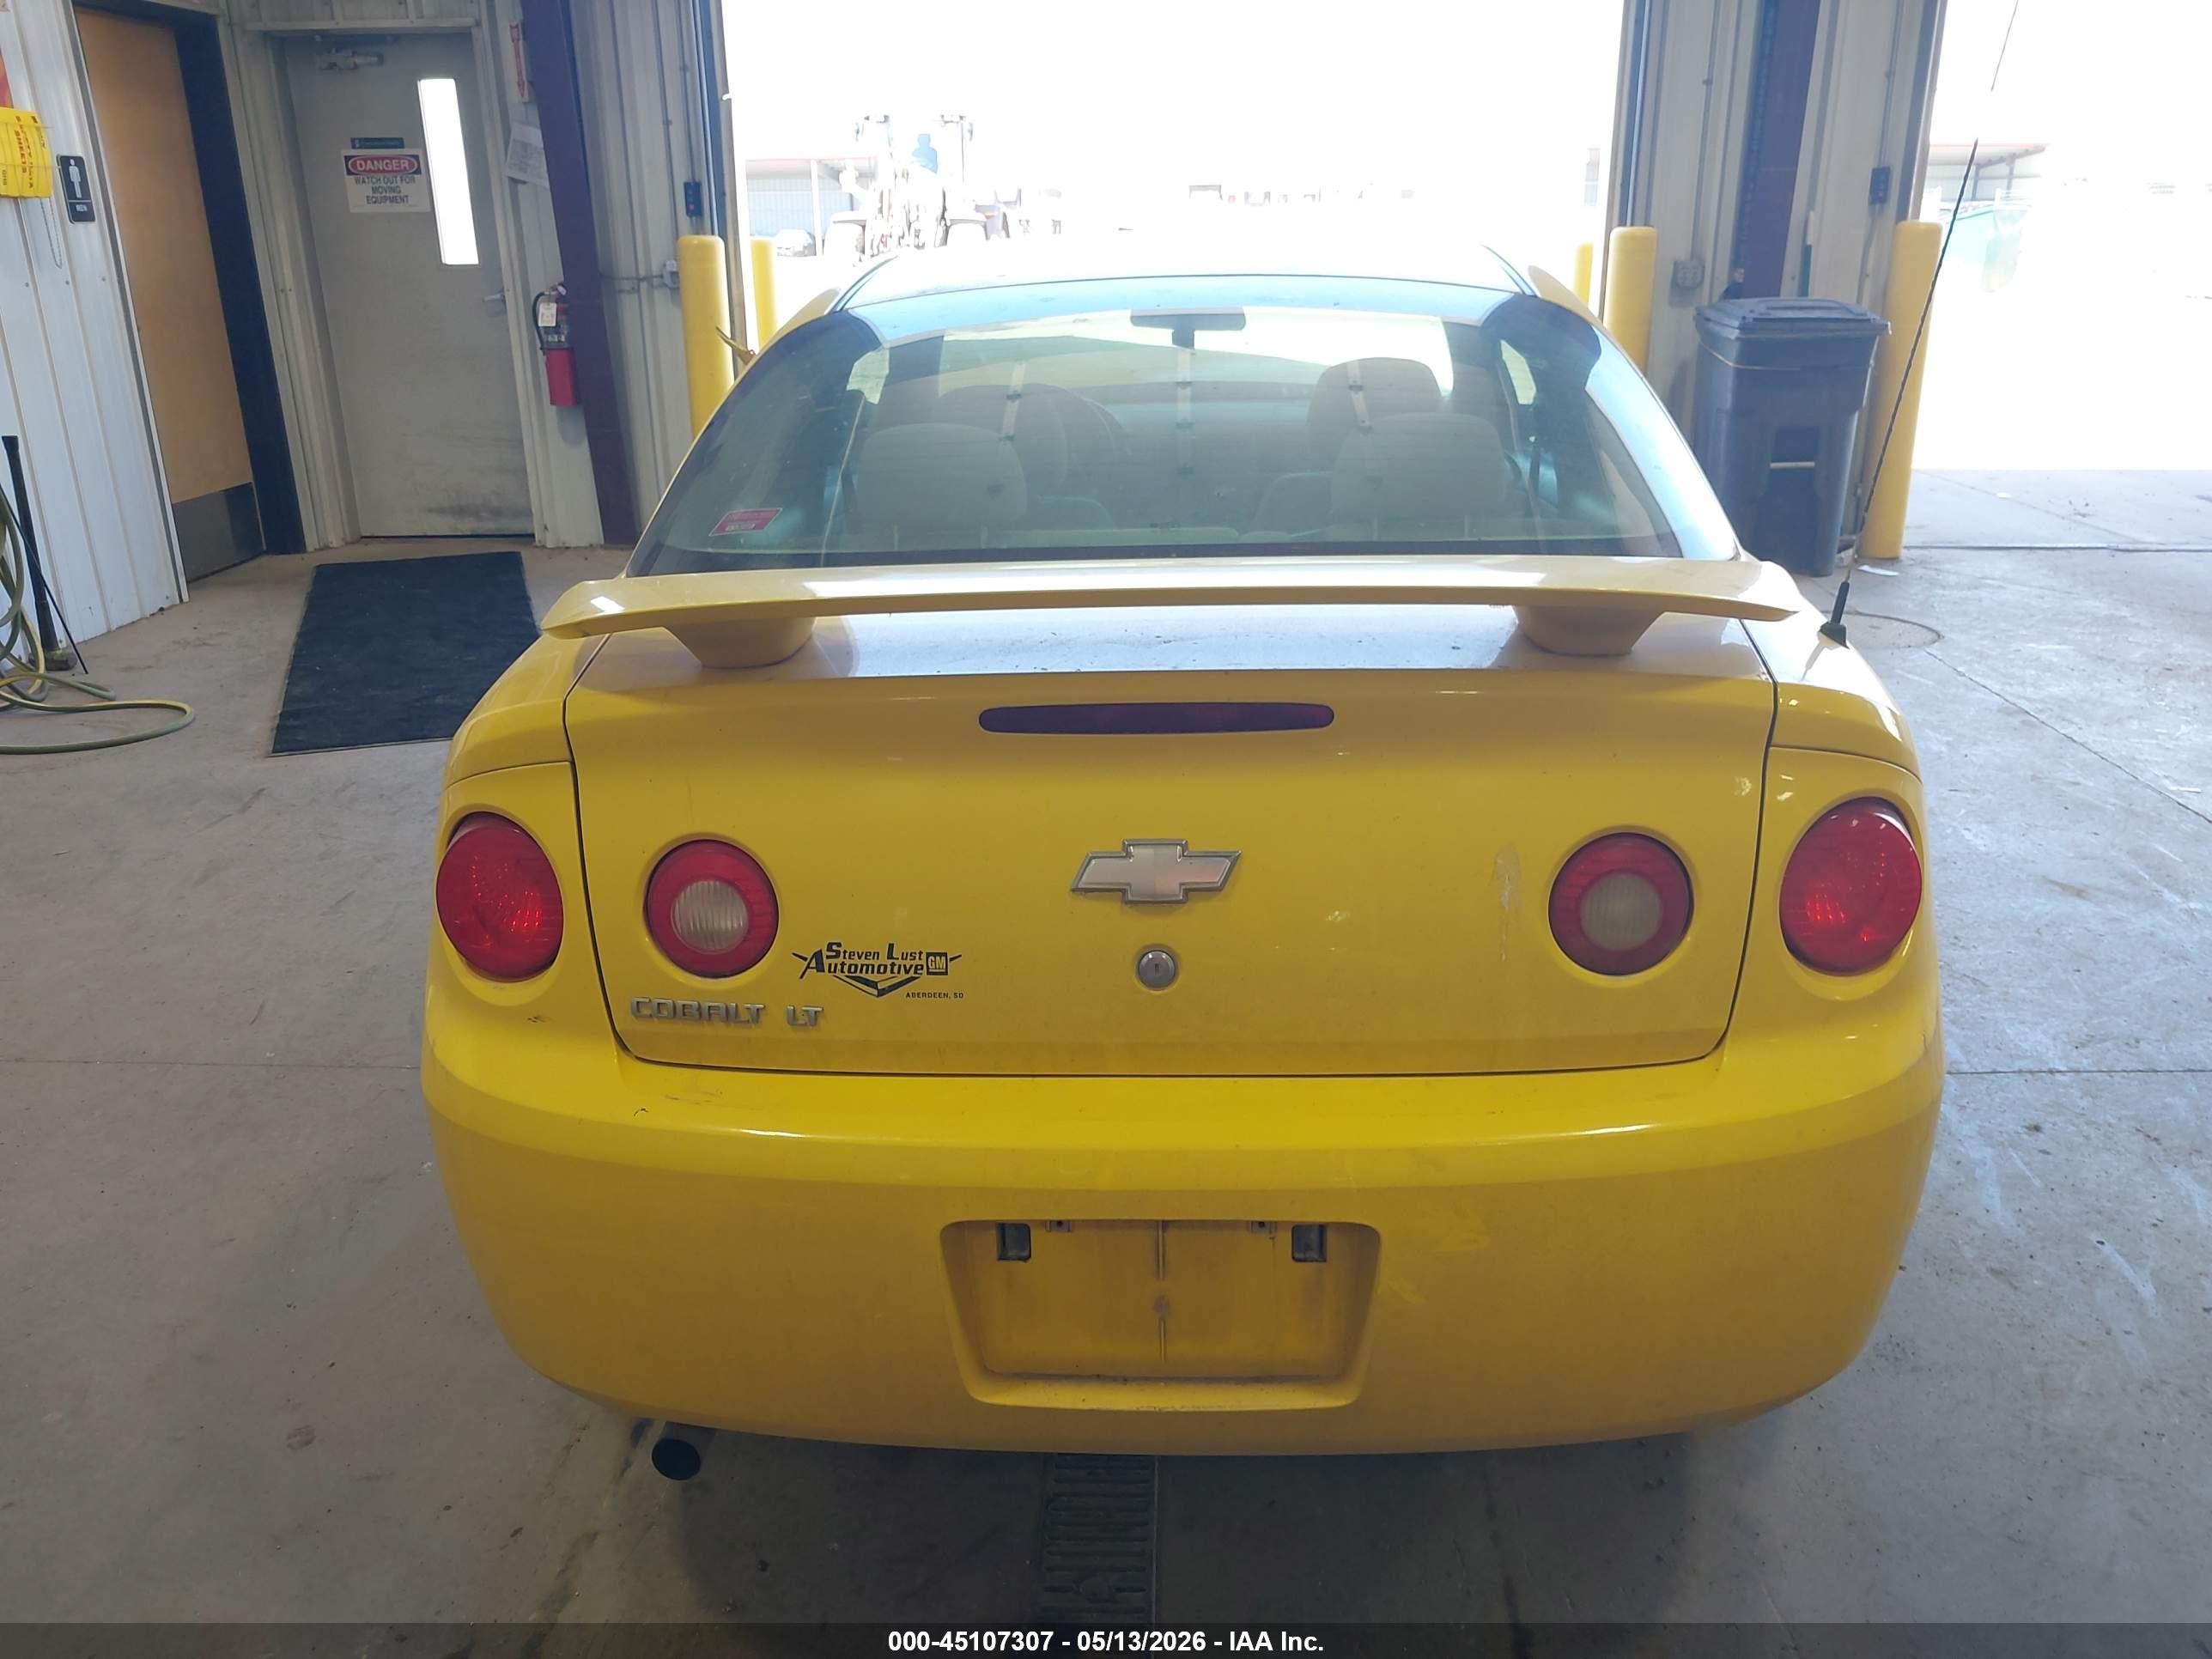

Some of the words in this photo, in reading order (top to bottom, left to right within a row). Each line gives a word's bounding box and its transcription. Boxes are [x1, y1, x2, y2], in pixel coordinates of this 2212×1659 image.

[356, 159, 410, 171] DANGER
[355, 176, 381, 185] WATCH
[383, 176, 398, 185] OUT
[399, 175, 416, 184] FOR
[372, 185, 401, 194] MOVING
[366, 195, 409, 204] EQUIPMENT
[799, 949, 925, 979] Automotive
[927, 955, 946, 972] GM
[630, 996, 766, 1025] COBALT
[786, 1005, 824, 1026] LT
